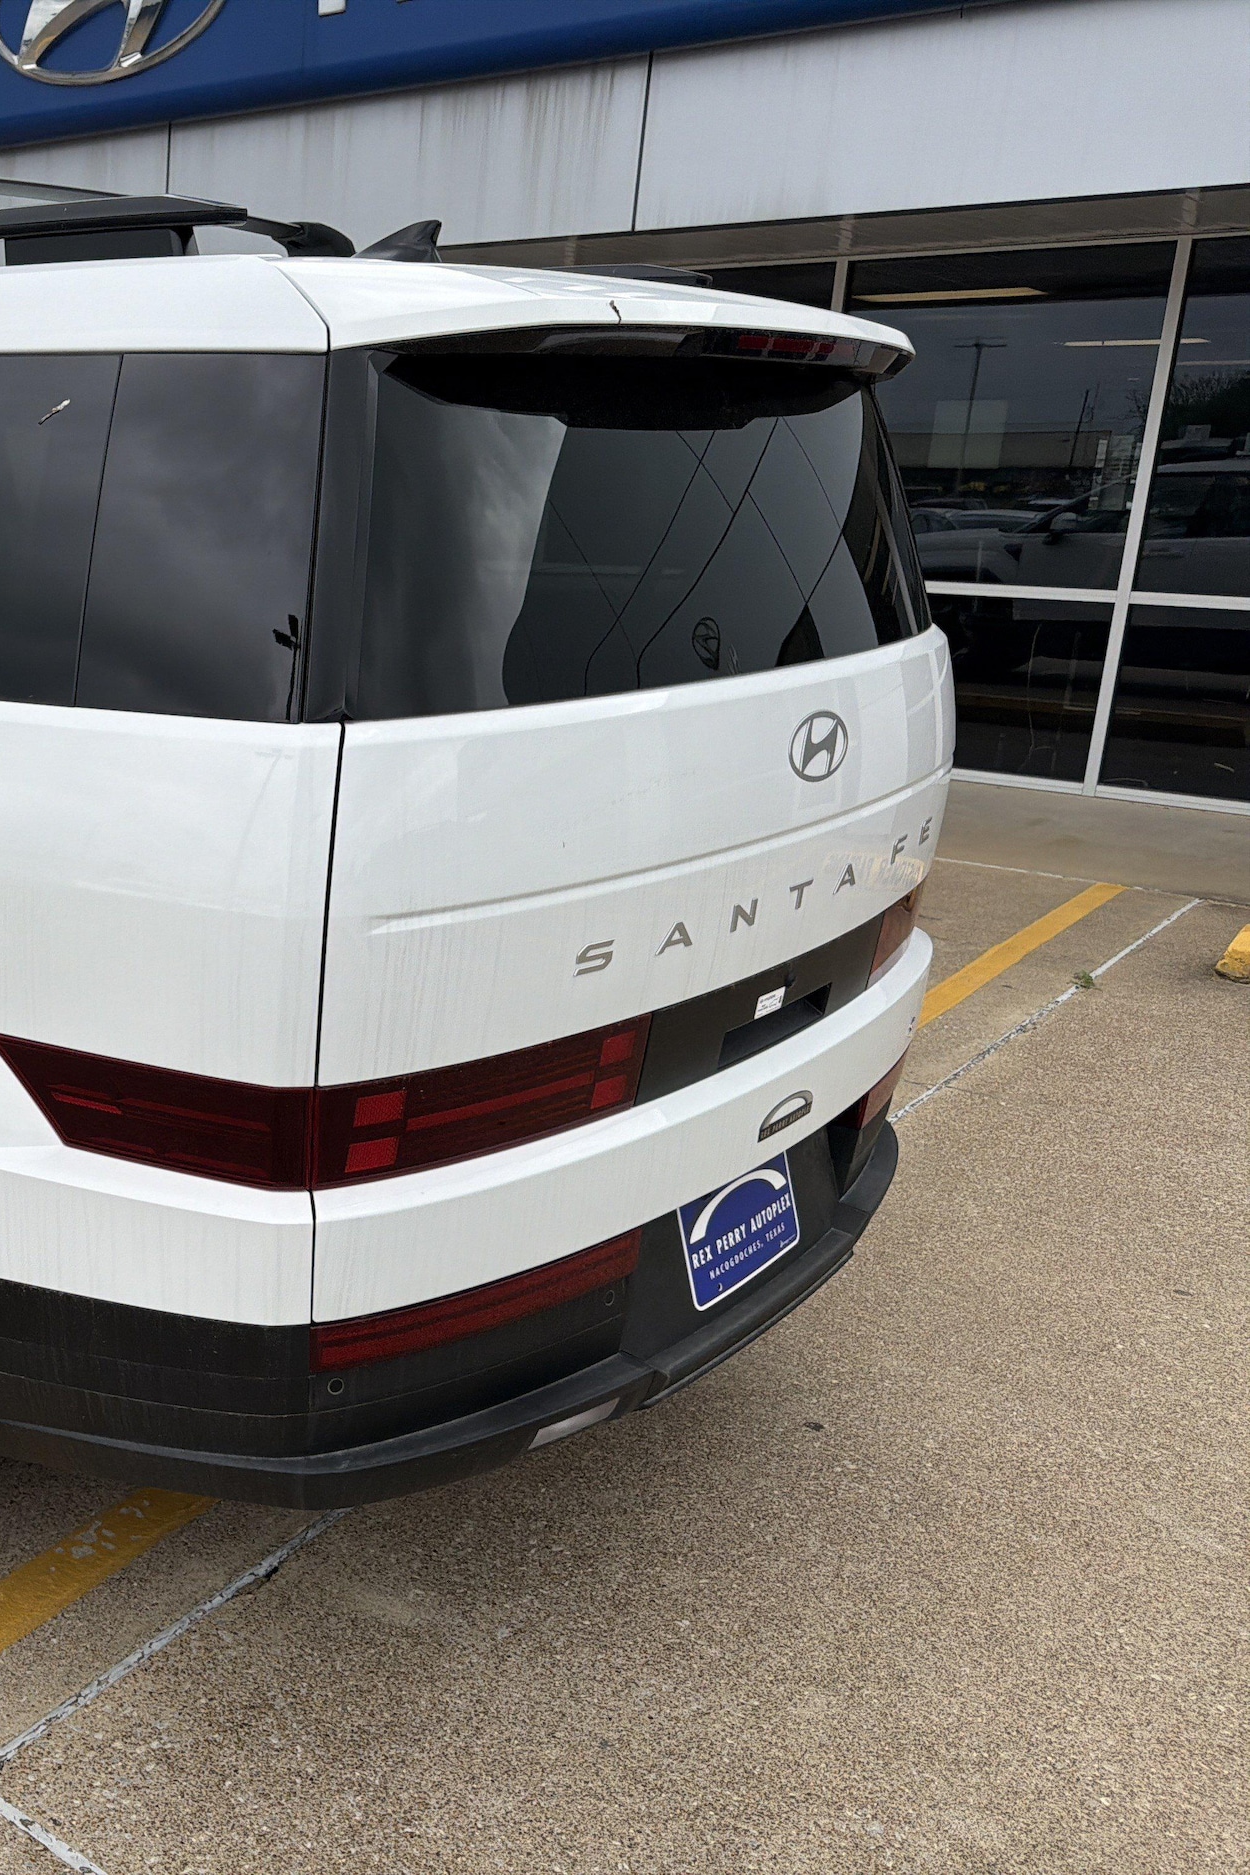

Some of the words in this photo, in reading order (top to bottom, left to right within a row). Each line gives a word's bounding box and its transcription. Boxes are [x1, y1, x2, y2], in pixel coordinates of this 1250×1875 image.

[573, 863, 856, 977] SANTA
[890, 816, 933, 865] FE
[692, 1246, 714, 1269] REX
[716, 1224, 746, 1254] PERRY
[751, 1193, 791, 1233] AUTOPLEX
[765, 1222, 786, 1243] TEXAS
